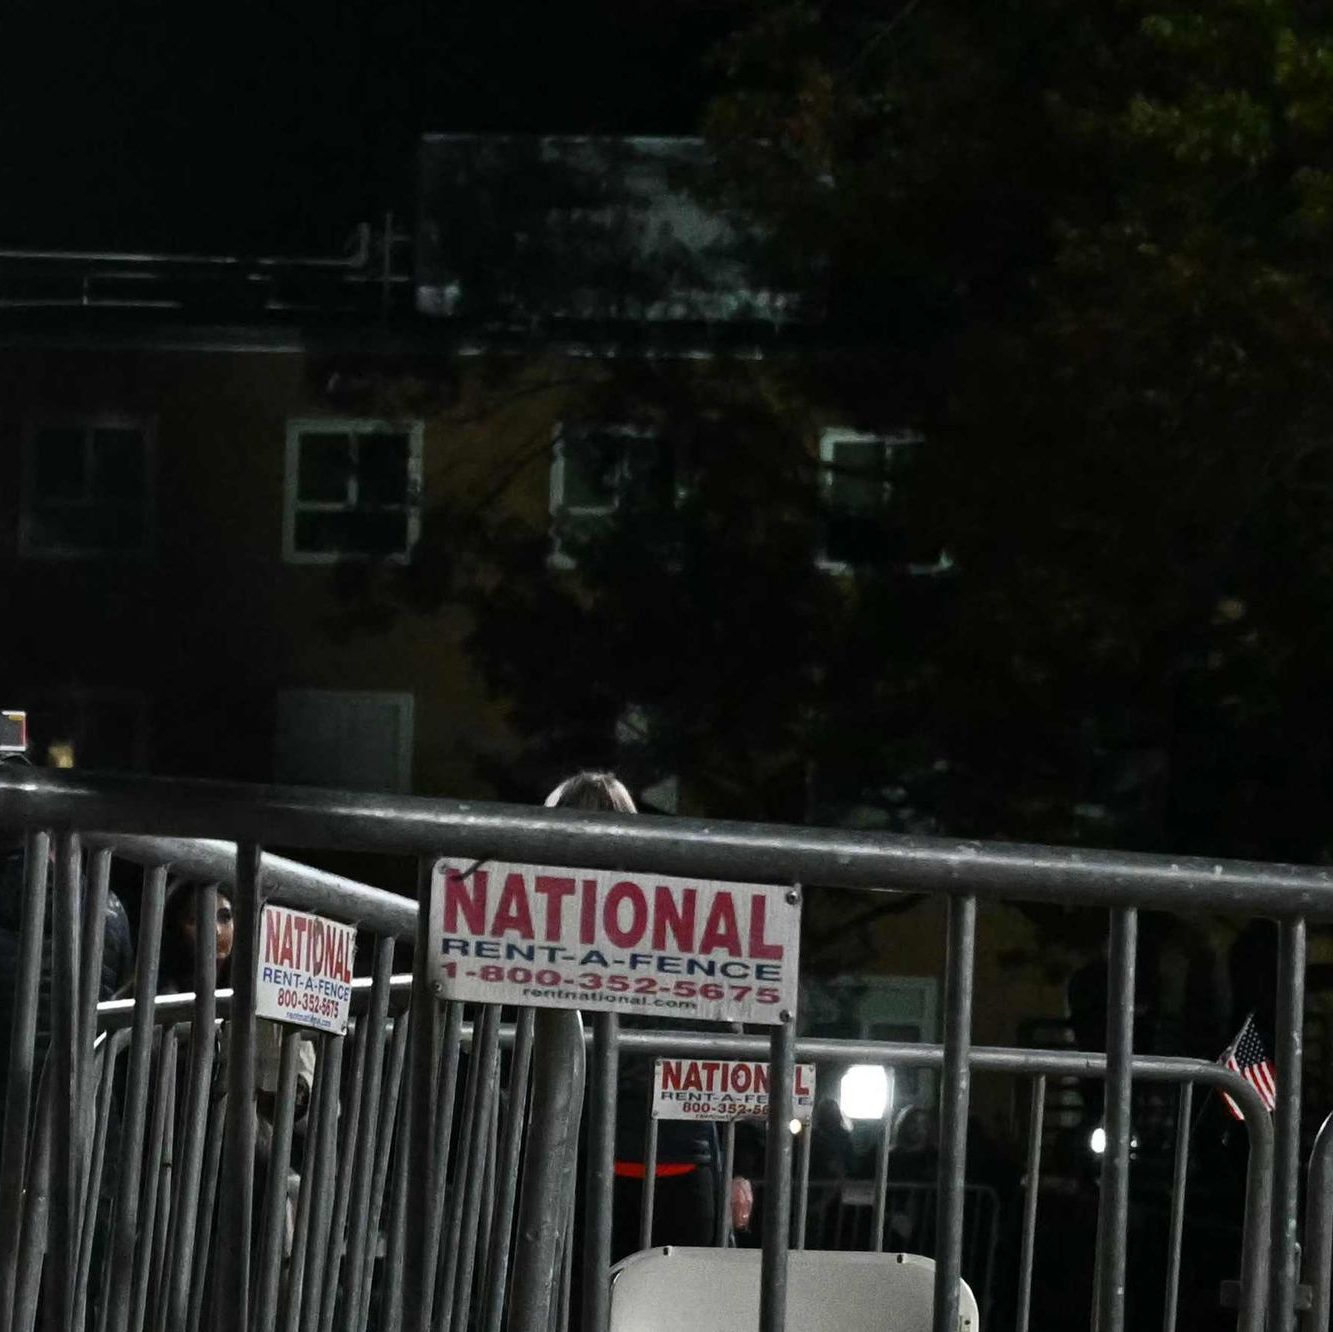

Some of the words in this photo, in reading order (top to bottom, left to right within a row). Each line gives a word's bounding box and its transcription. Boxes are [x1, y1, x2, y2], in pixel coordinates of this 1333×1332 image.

[443, 868, 784, 960] NATIONAL
[264, 909, 351, 984] NATIONAL
[441, 938, 783, 982] RENT-A-FENCE
[263, 967, 350, 1001] RENT-A-FENCE
[278, 988, 339, 1018] 800-352-5675
[441, 961, 782, 1005] 1-800-352-5675
[661, 1060, 810, 1096] NATIONL
